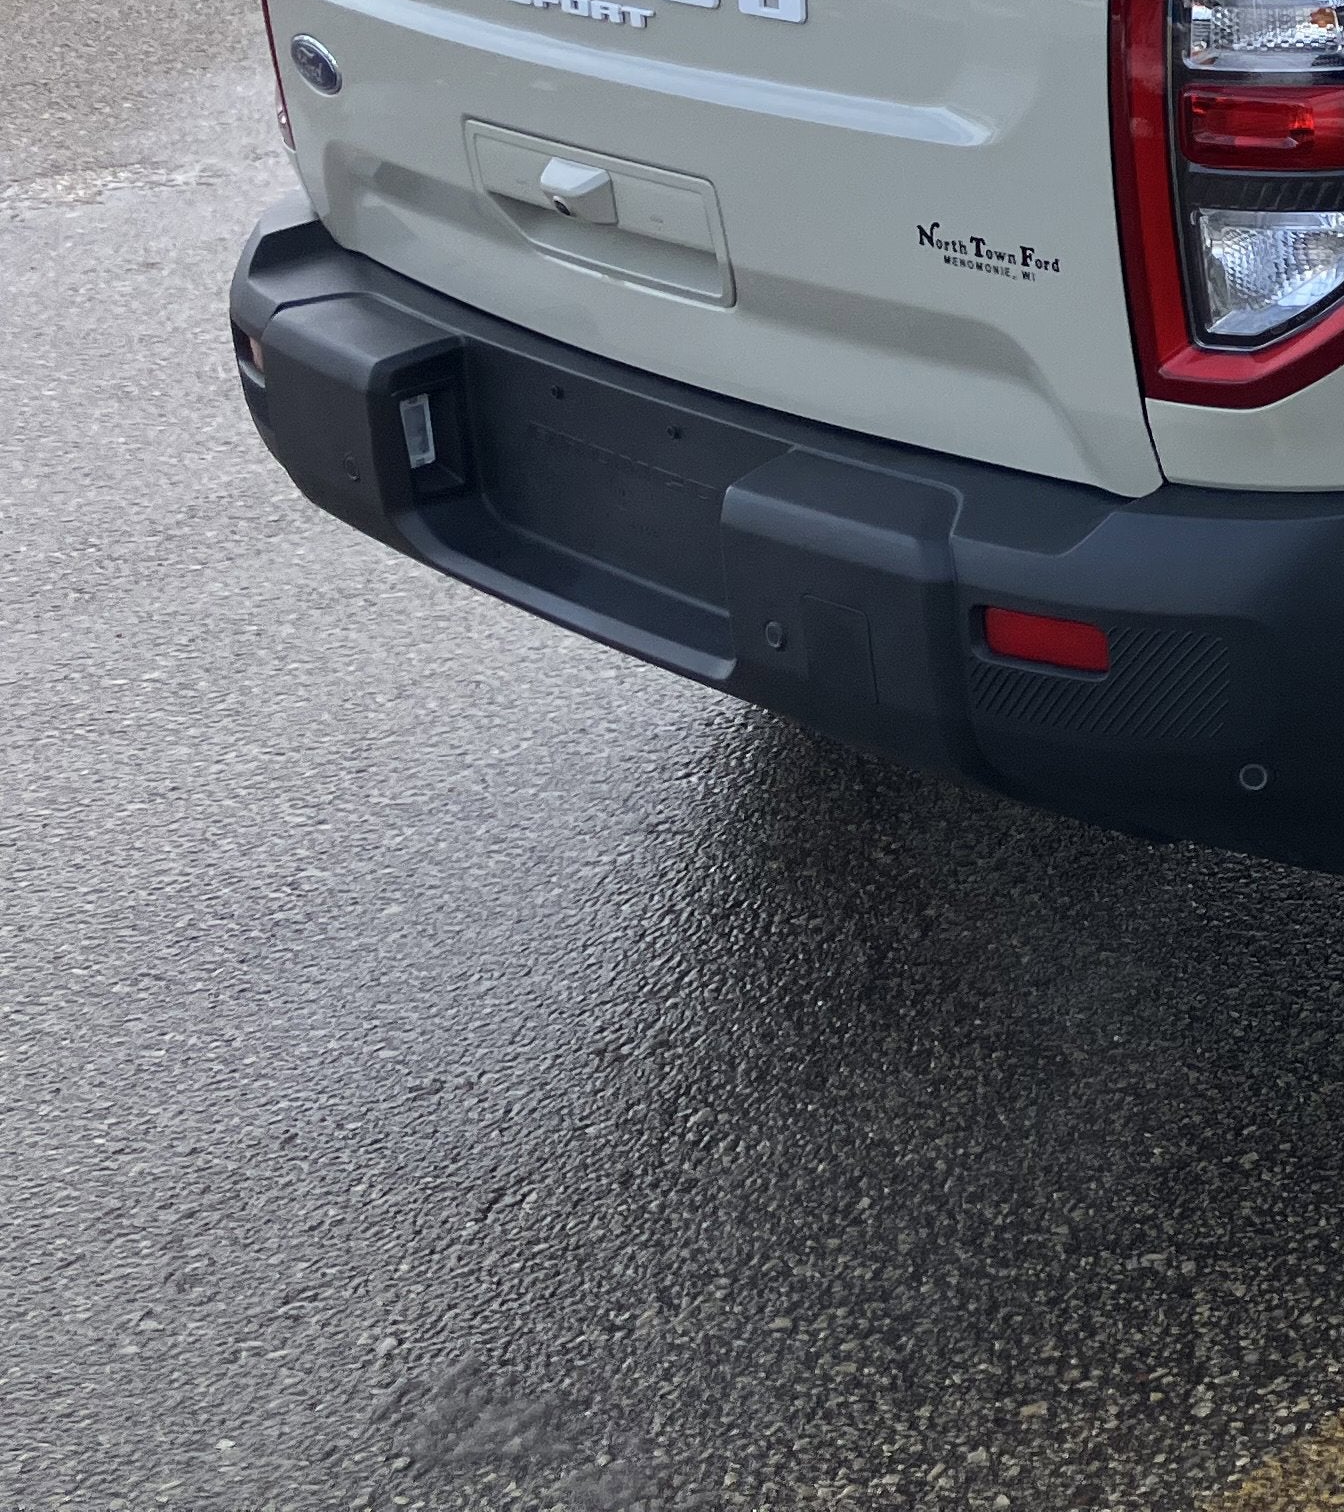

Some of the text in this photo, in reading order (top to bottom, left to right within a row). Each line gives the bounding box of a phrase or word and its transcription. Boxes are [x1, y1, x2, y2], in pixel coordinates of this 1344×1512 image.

[916, 221, 1061, 273] North Town Ford
[1021, 269, 1036, 282] WI
